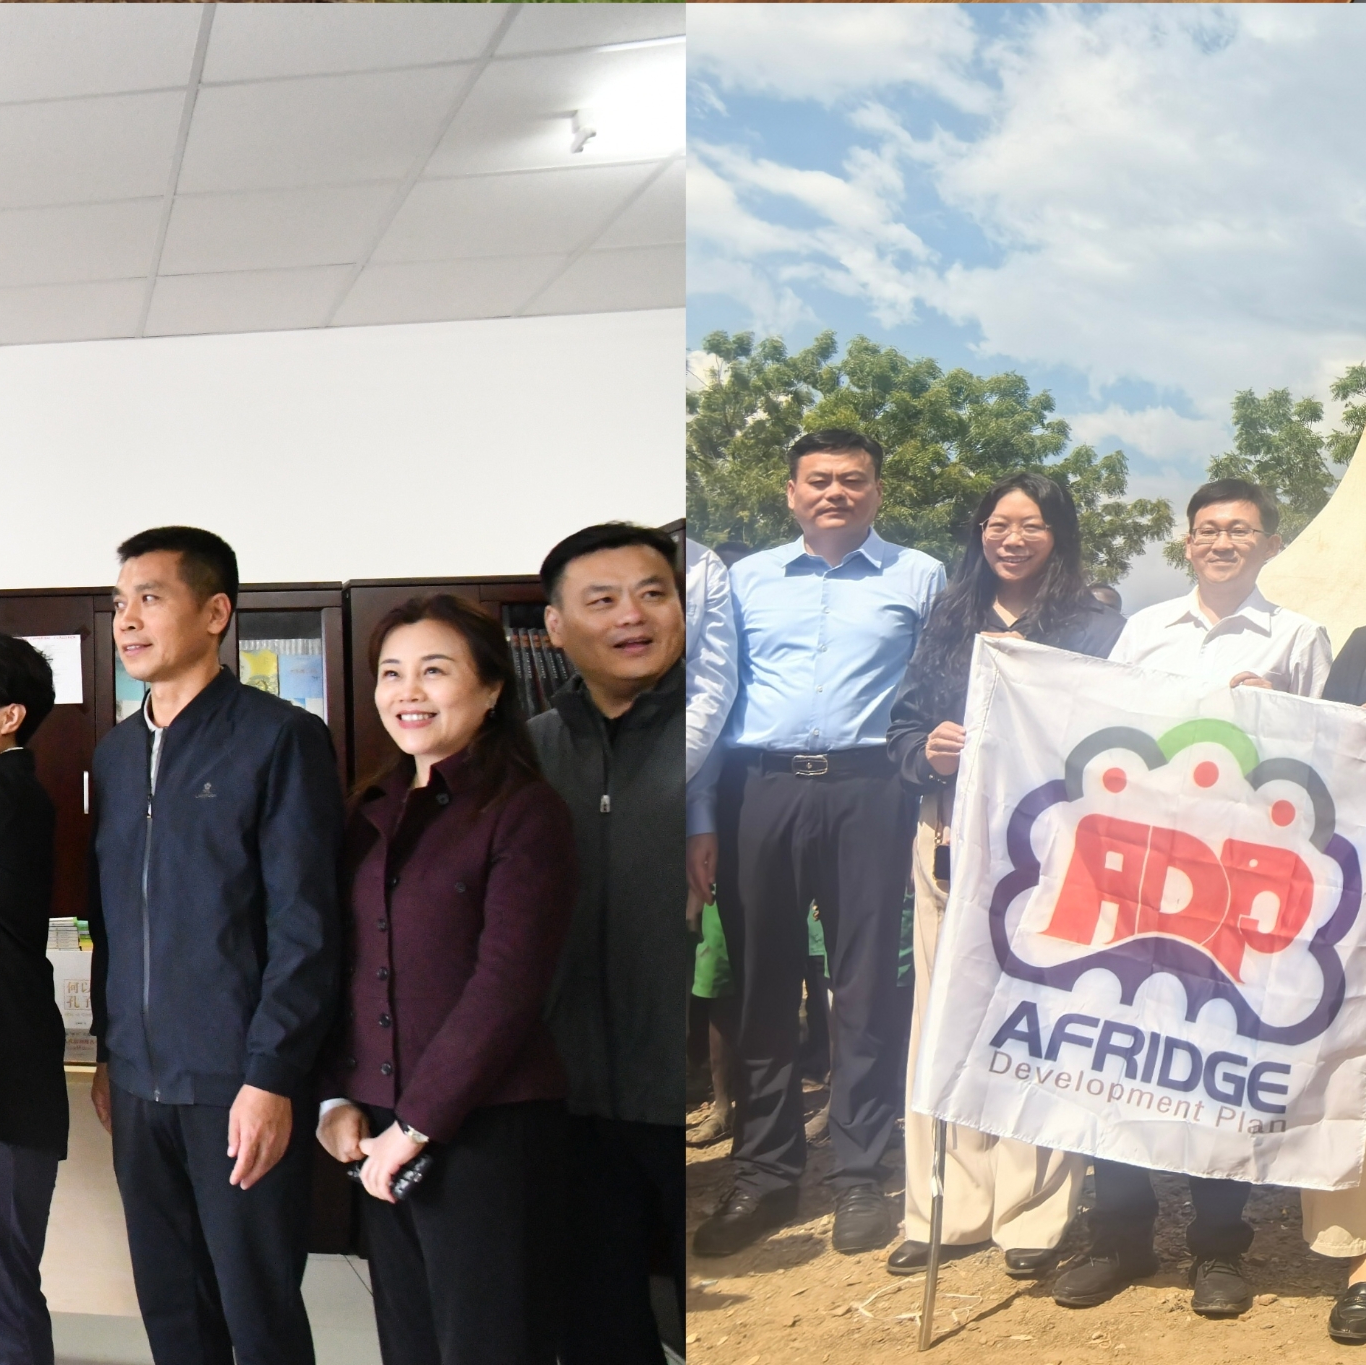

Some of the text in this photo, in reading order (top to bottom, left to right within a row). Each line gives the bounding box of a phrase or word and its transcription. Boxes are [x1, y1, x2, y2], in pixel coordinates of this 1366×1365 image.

[1036, 813, 1315, 984] ADP
[988, 1050, 1288, 1135] Development Plan
[989, 1001, 1292, 1115] AFRIDGE
